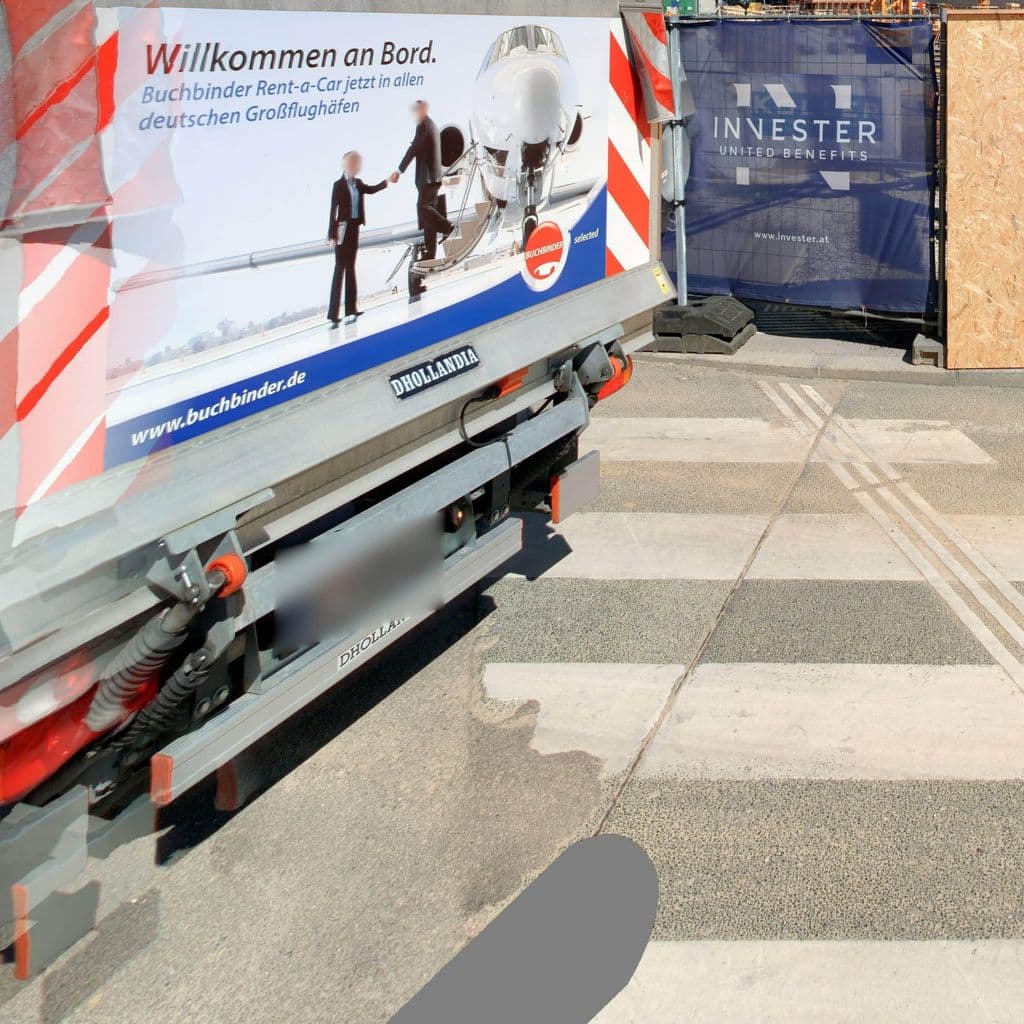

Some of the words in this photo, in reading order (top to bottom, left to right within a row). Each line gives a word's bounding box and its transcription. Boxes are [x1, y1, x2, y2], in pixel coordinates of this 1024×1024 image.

[146, 42, 337, 75] Willkommen
[344, 45, 374, 67] an
[380, 40, 437, 66] Bord.
[142, 81, 252, 104] Buchbinder
[256, 77, 342, 97] Rent-a-Car
[344, 74, 375, 94] jetzt
[379, 74, 390, 89] in
[394, 73, 424, 88] allen
[139, 109, 240, 131] deutschen
[245, 98, 360, 122] Großflughäfen
[713, 116, 876, 144] INVESTER
[719, 145, 775, 158] UNITED
[784, 148, 868, 161] BENEFITS
[525, 241, 564, 260] BUCHBINDER
[754, 231, 830, 244] www.invester.at
[391, 347, 480, 397] DHOLLANDIA
[130, 371, 306, 447] www.buchbinder.de
